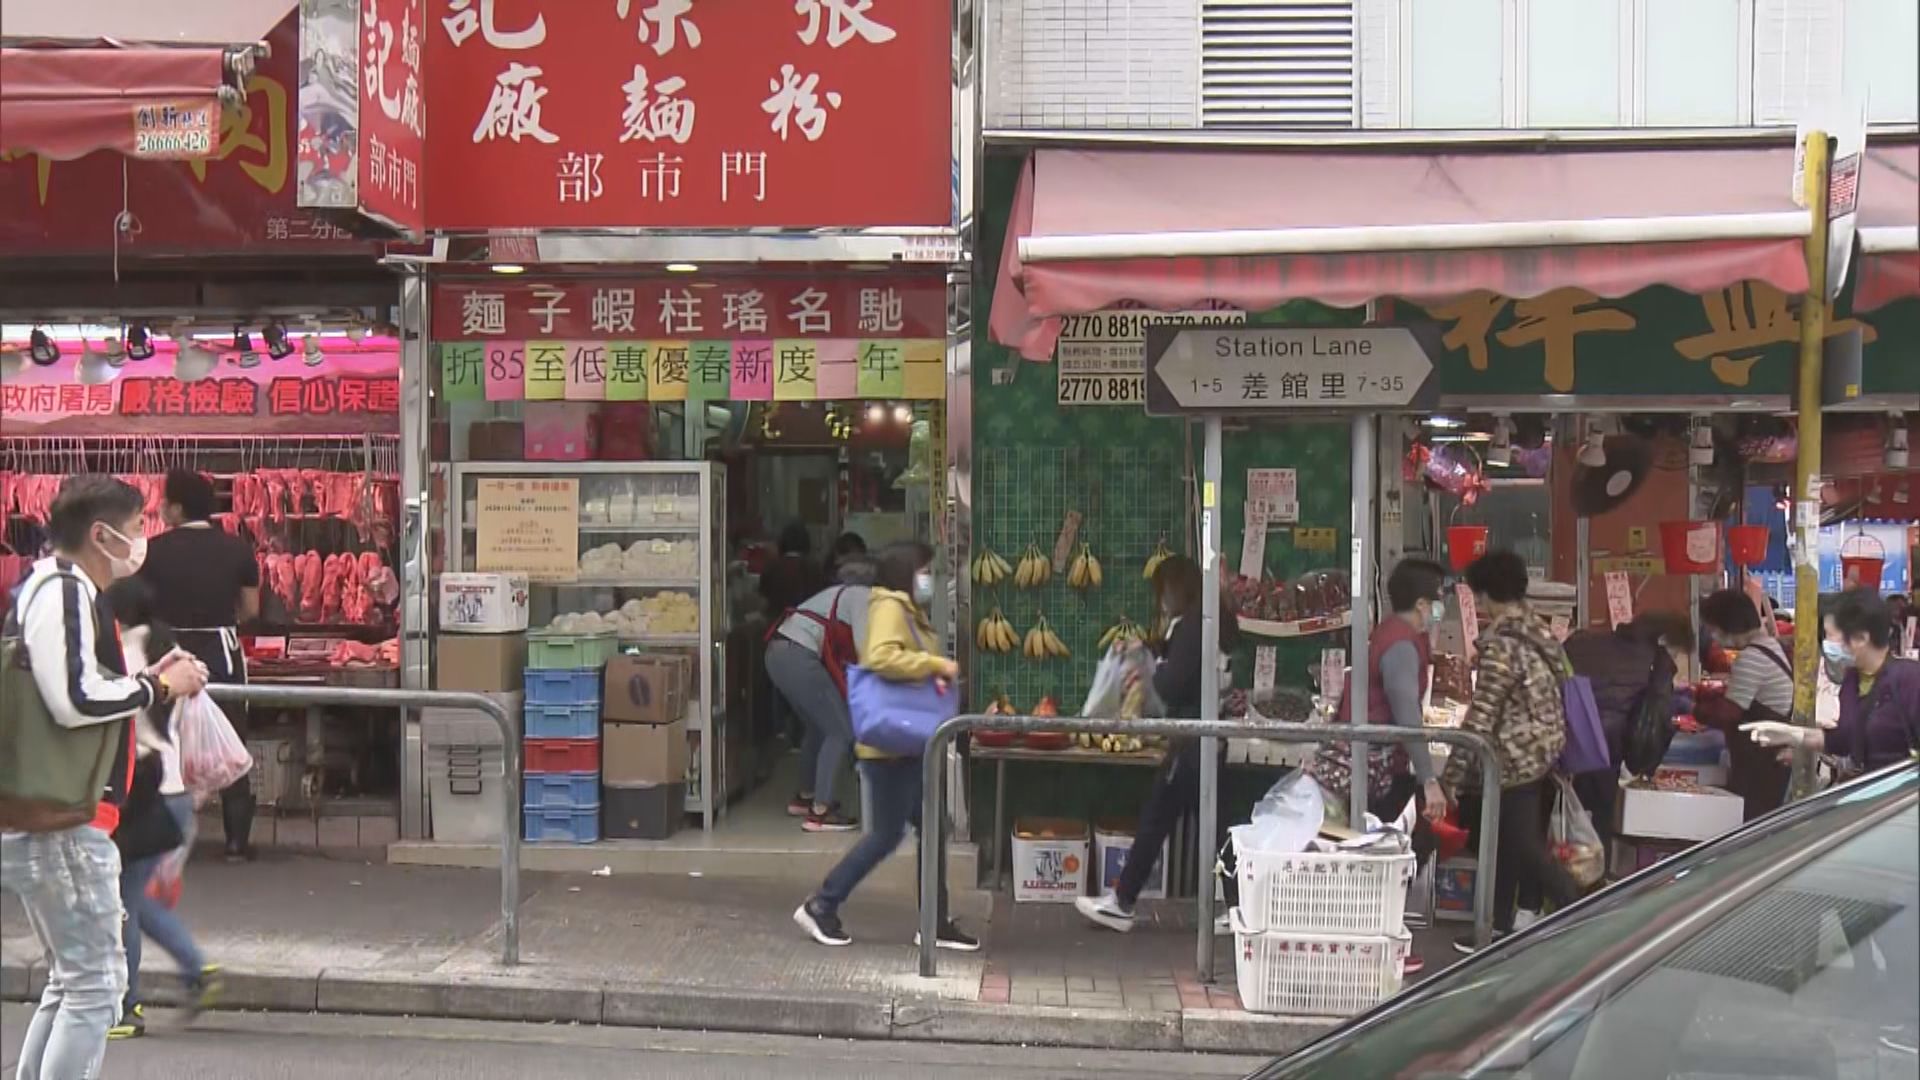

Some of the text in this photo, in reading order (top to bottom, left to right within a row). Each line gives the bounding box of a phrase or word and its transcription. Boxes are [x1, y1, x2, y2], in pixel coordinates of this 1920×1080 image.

[138, 132, 209, 151] 26666426
[1060, 315, 1103, 337] 2770
[1215, 336, 1372, 357] Station Lane
[120, 379, 256, 414] 嚴格檢驗
[268, 380, 399, 414] 信心保證
[1060, 378, 1103, 400] 2770
[1191, 372, 1404, 400] 1-5 差館里 7-35
